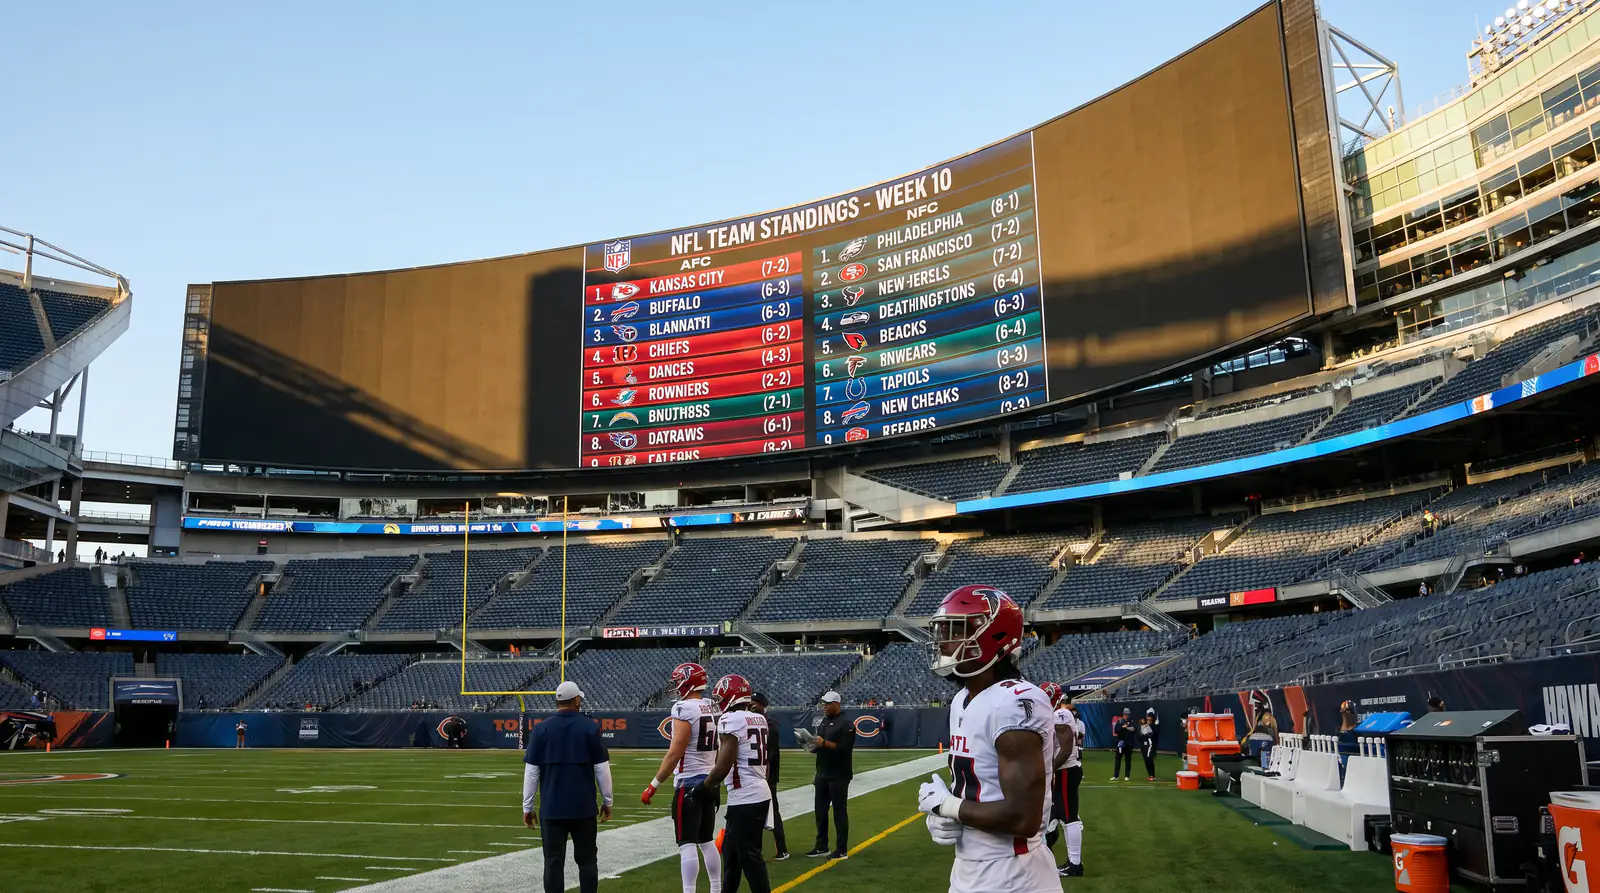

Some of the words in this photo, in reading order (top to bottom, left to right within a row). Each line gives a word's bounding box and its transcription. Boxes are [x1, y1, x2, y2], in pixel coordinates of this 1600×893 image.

[671, 232, 703, 256] NFL
[707, 221, 755, 249] TEAM
[760, 196, 859, 239] STANDINGS
[875, 175, 927, 211] WEEK
[931, 168, 952, 192] 10
[821, 249, 830, 263] 1.
[877, 211, 964, 249] PHILADELPHIA
[991, 191, 1019, 218] (8-1)
[906, 201, 939, 221] NFC
[680, 256, 711, 271] AFC
[821, 272, 832, 286] 2.
[877, 253, 901, 272] SAN
[904, 233, 973, 265] FRANCISCO
[991, 216, 1020, 242] (7-2)
[595, 288, 604, 301] 1.
[649, 274, 696, 294] KANSAS
[698, 269, 725, 286] CITY
[761, 256, 790, 277] (7-2)
[821, 294, 832, 308] 3.
[878, 276, 905, 296] NEW
[993, 241, 1022, 267] (7-2)
[593, 309, 605, 322] 2.
[649, 295, 701, 315] BUFFALO
[761, 279, 790, 299] (6-3)
[821, 317, 833, 331] 4.
[993, 267, 1024, 292] (6-4)
[592, 350, 604, 363] 4.
[649, 341, 690, 357] CHIEFS
[761, 324, 791, 344] (6-2)
[593, 329, 605, 342] 3.
[761, 301, 791, 322] (6-3)
[822, 340, 833, 354] 5.
[879, 319, 927, 344] BEACKS
[994, 292, 1025, 317] (6-3)
[592, 372, 604, 385] 5.
[649, 361, 694, 379] DANCES
[761, 346, 791, 366] (4-3)
[822, 363, 833, 378] 6.
[996, 318, 1027, 342] (6-4)
[592, 393, 603, 406] 6.
[649, 382, 709, 401] ROWNIERS
[762, 370, 791, 389] (2-2)
[823, 386, 833, 401] 7.
[880, 368, 930, 391] TAPIOLS
[997, 344, 1028, 368] (3-3)
[592, 414, 602, 428] 7.
[763, 393, 791, 412] (2-1)
[823, 410, 835, 425] 8.
[881, 396, 908, 415] NEW
[911, 387, 960, 410] CHEAKS
[998, 370, 1029, 394] (8-2)
[591, 437, 602, 450] 8.
[648, 427, 704, 445] DAYRAWS
[763, 416, 791, 435] (6-1)
[949, 735, 970, 754] ATL
